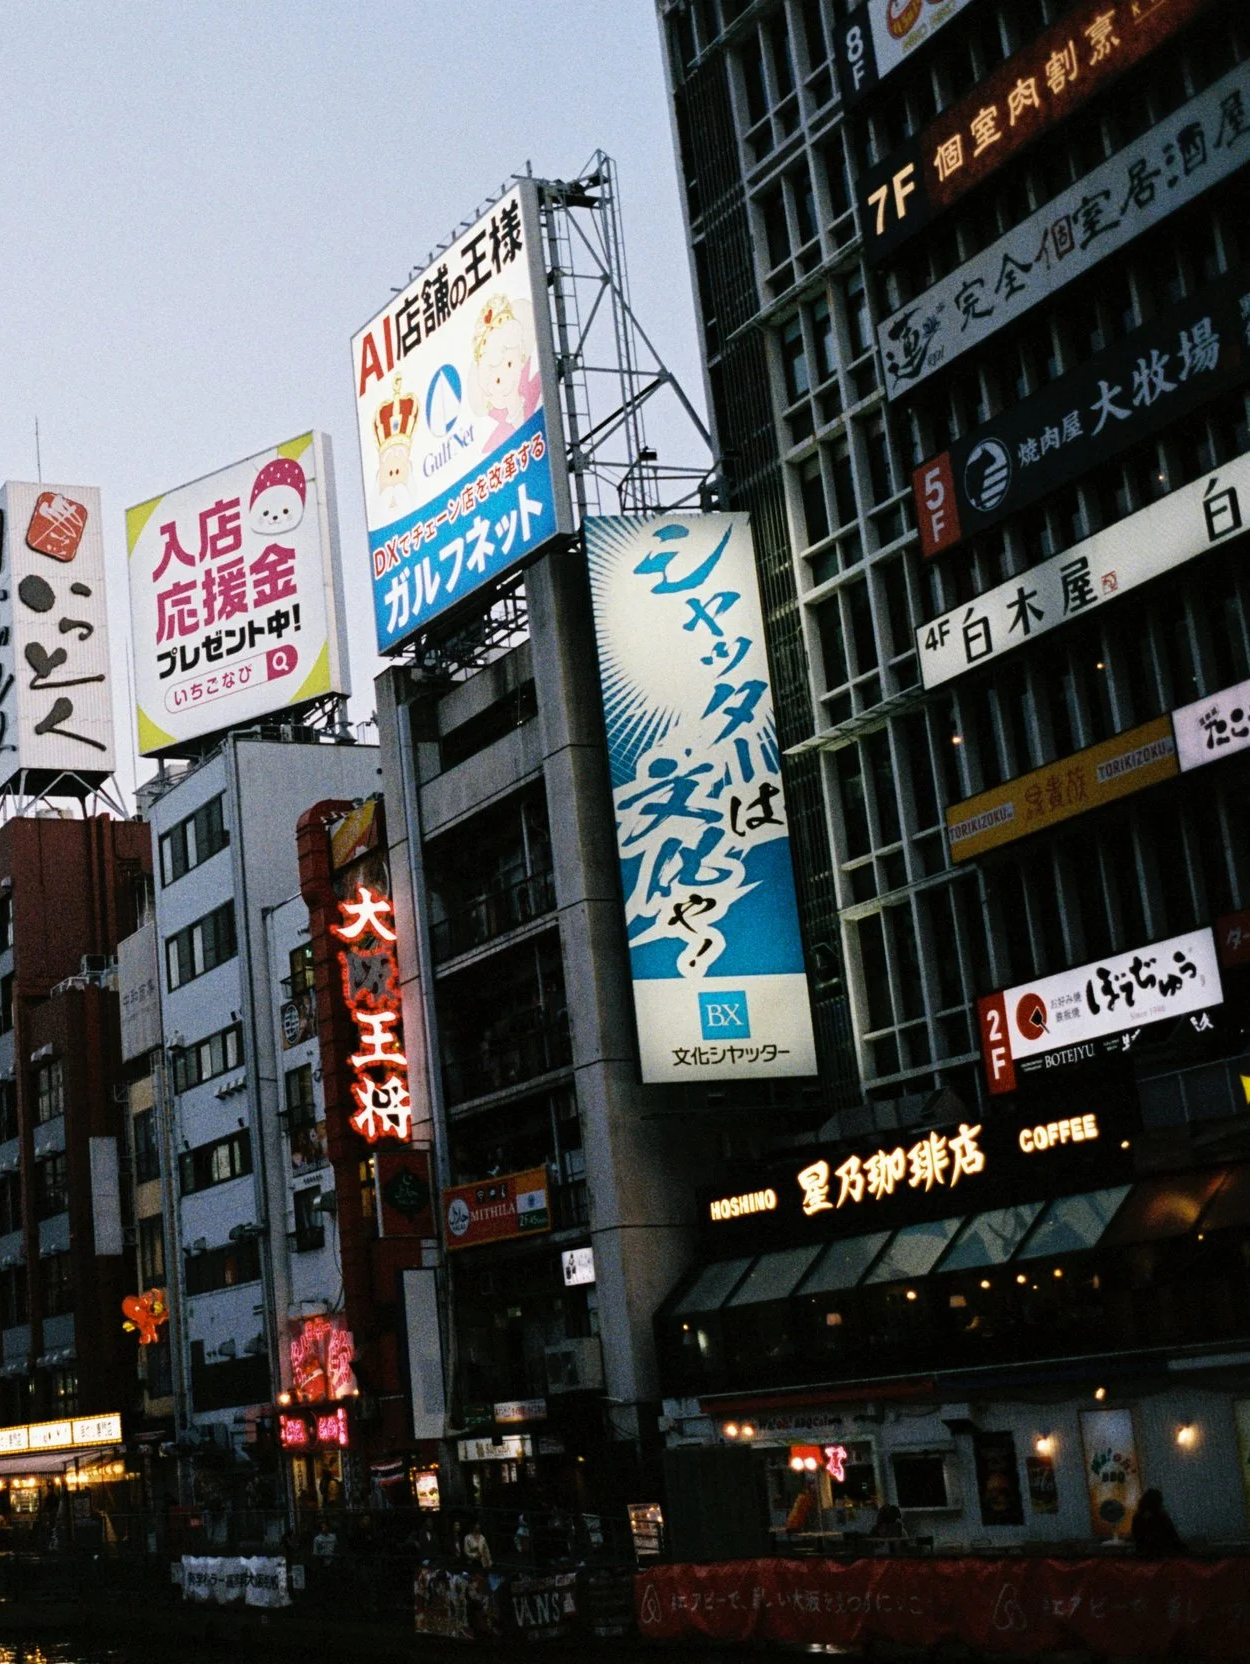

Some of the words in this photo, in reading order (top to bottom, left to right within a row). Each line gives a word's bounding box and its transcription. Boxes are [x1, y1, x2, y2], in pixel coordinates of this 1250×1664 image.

[846, 25, 865, 91] 8F
[867, 164, 915, 236] 7F
[359, 199, 523, 398] AI店舗の王様
[1017, 410, 1084, 468] 焼肉屋
[1090, 317, 1220, 436] 大牧場
[152, 497, 242, 583] 入店
[373, 433, 545, 578] DXでチェーン店を改革する
[925, 467, 946, 543] 5F
[156, 543, 297, 645] 応援金
[385, 483, 542, 634] ガルフネット
[925, 619, 949, 651] 4F
[962, 556, 1098, 663] 白木屋
[174, 663, 253, 706] いちごなび
[706, 1004, 743, 1026] BX
[986, 1009, 1007, 1079] 2F
[797, 1124, 986, 1216] 星乃珈琲店
[1018, 1114, 1099, 1154] COFFEE
[470, 1203, 516, 1222] MITHILA
[711, 1189, 778, 1221] HOSHINO
